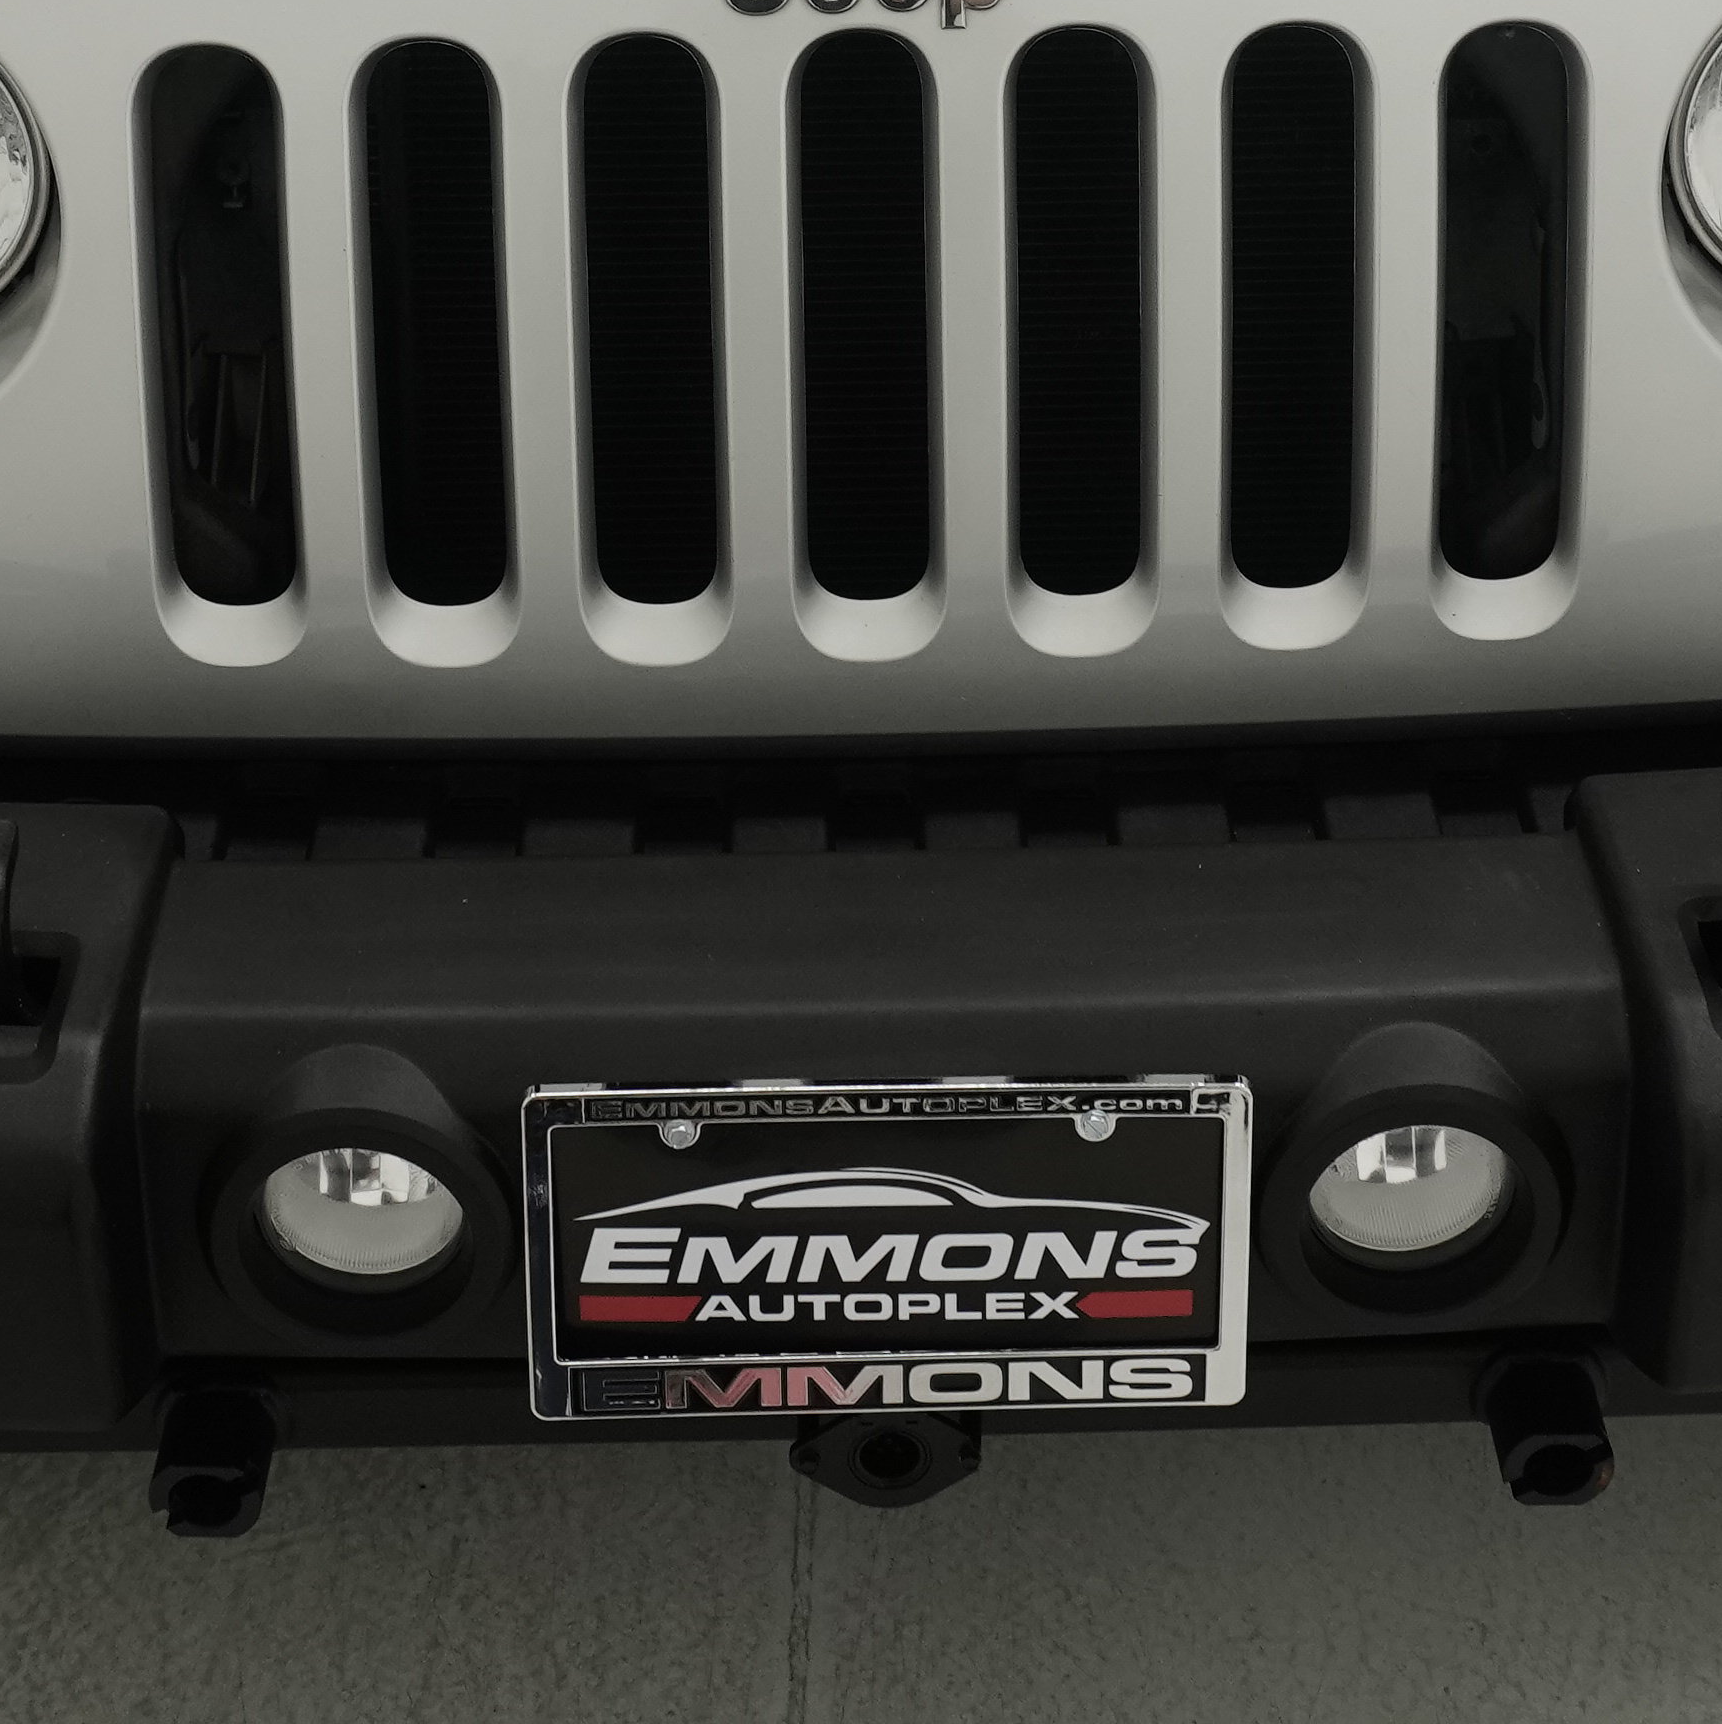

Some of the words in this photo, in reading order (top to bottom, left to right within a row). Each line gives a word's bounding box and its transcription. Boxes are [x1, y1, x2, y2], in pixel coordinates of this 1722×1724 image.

[579, 1227, 1201, 1284] EMMONS
[694, 1290, 1080, 1322] AUTOPLEX
[582, 1358, 1194, 1412] EMMONS
